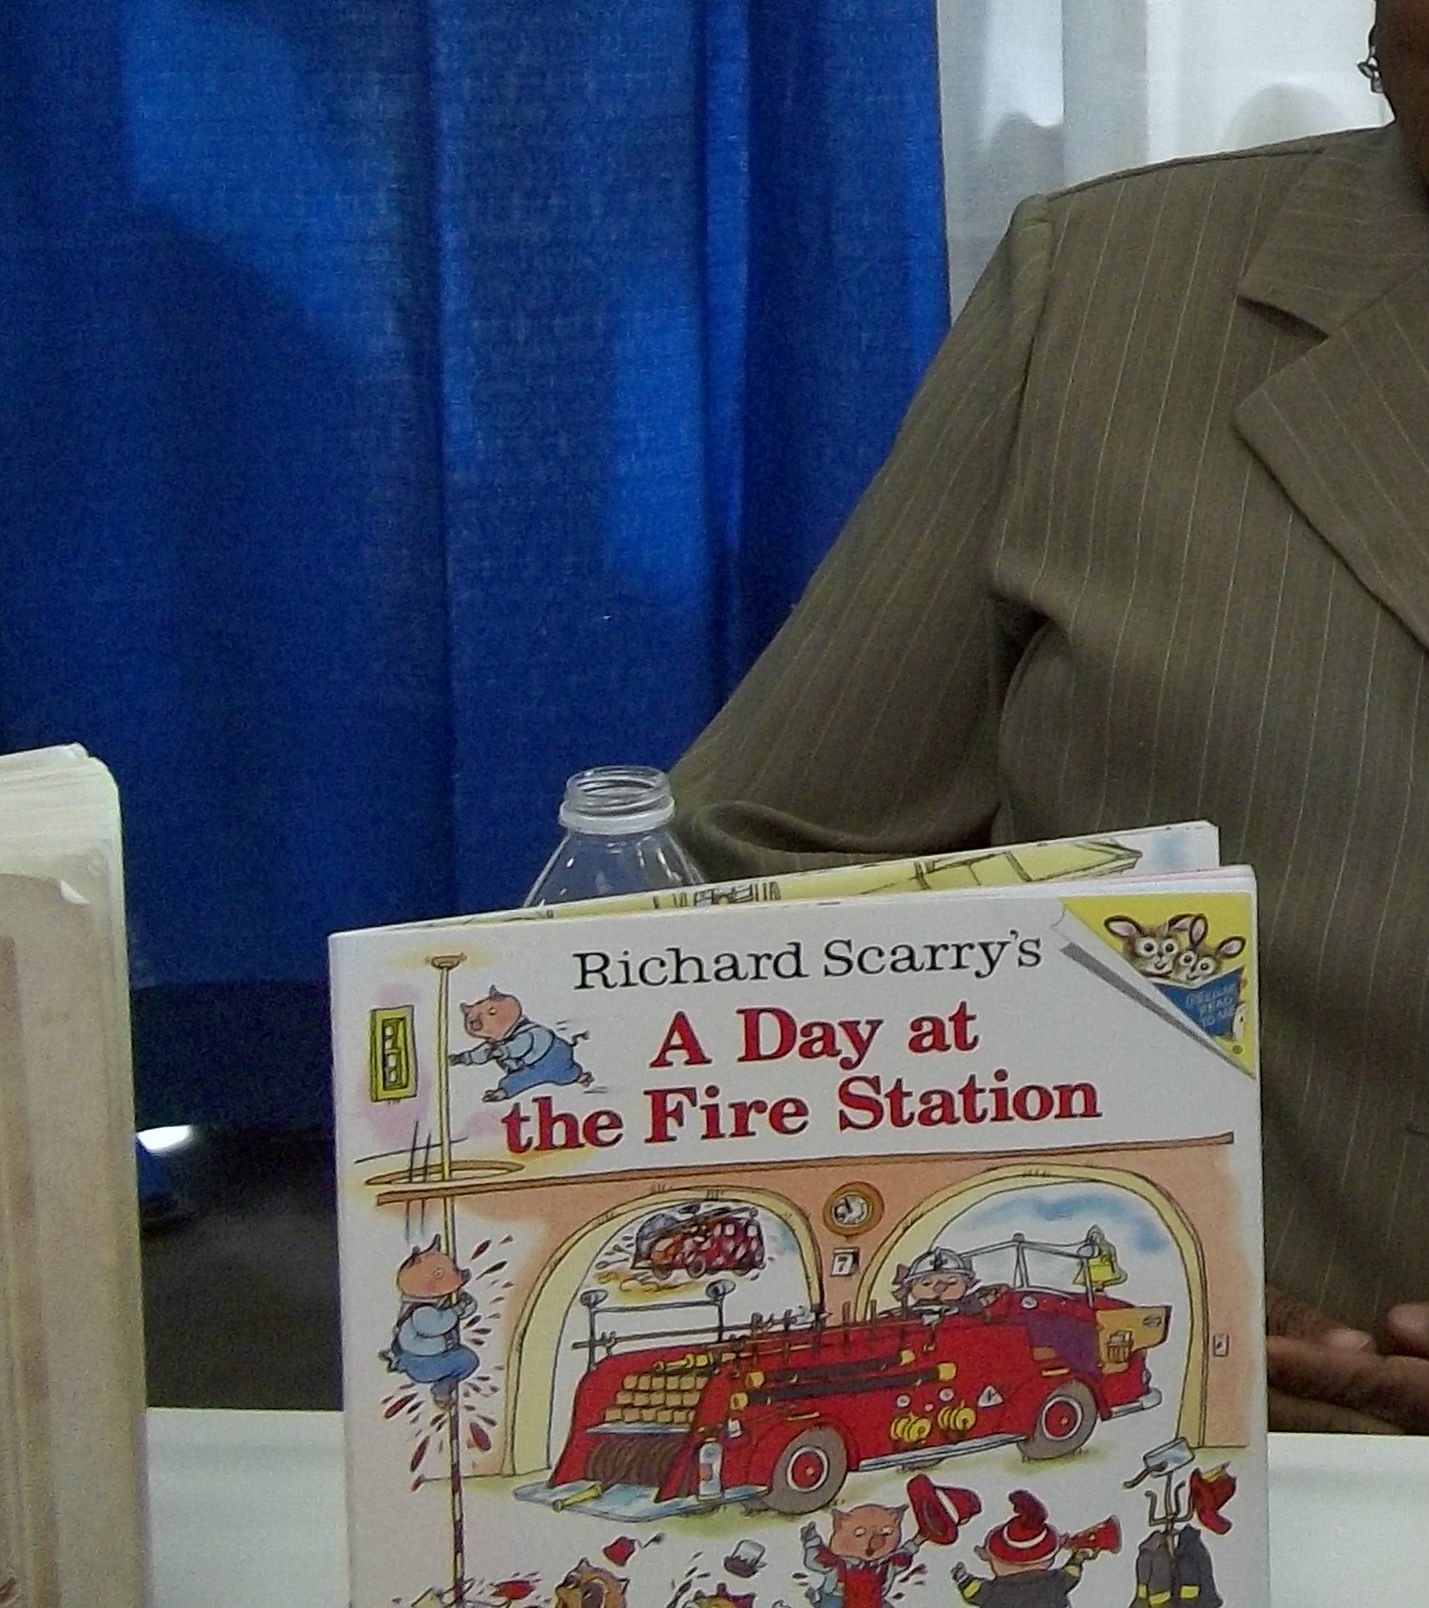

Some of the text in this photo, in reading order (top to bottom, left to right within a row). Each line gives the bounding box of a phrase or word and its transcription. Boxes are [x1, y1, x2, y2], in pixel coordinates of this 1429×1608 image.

[573, 930, 1041, 989] Richard Scarry's
[650, 1002, 978, 1070] A Day at
[501, 1069, 1102, 1154] the Fire Station
